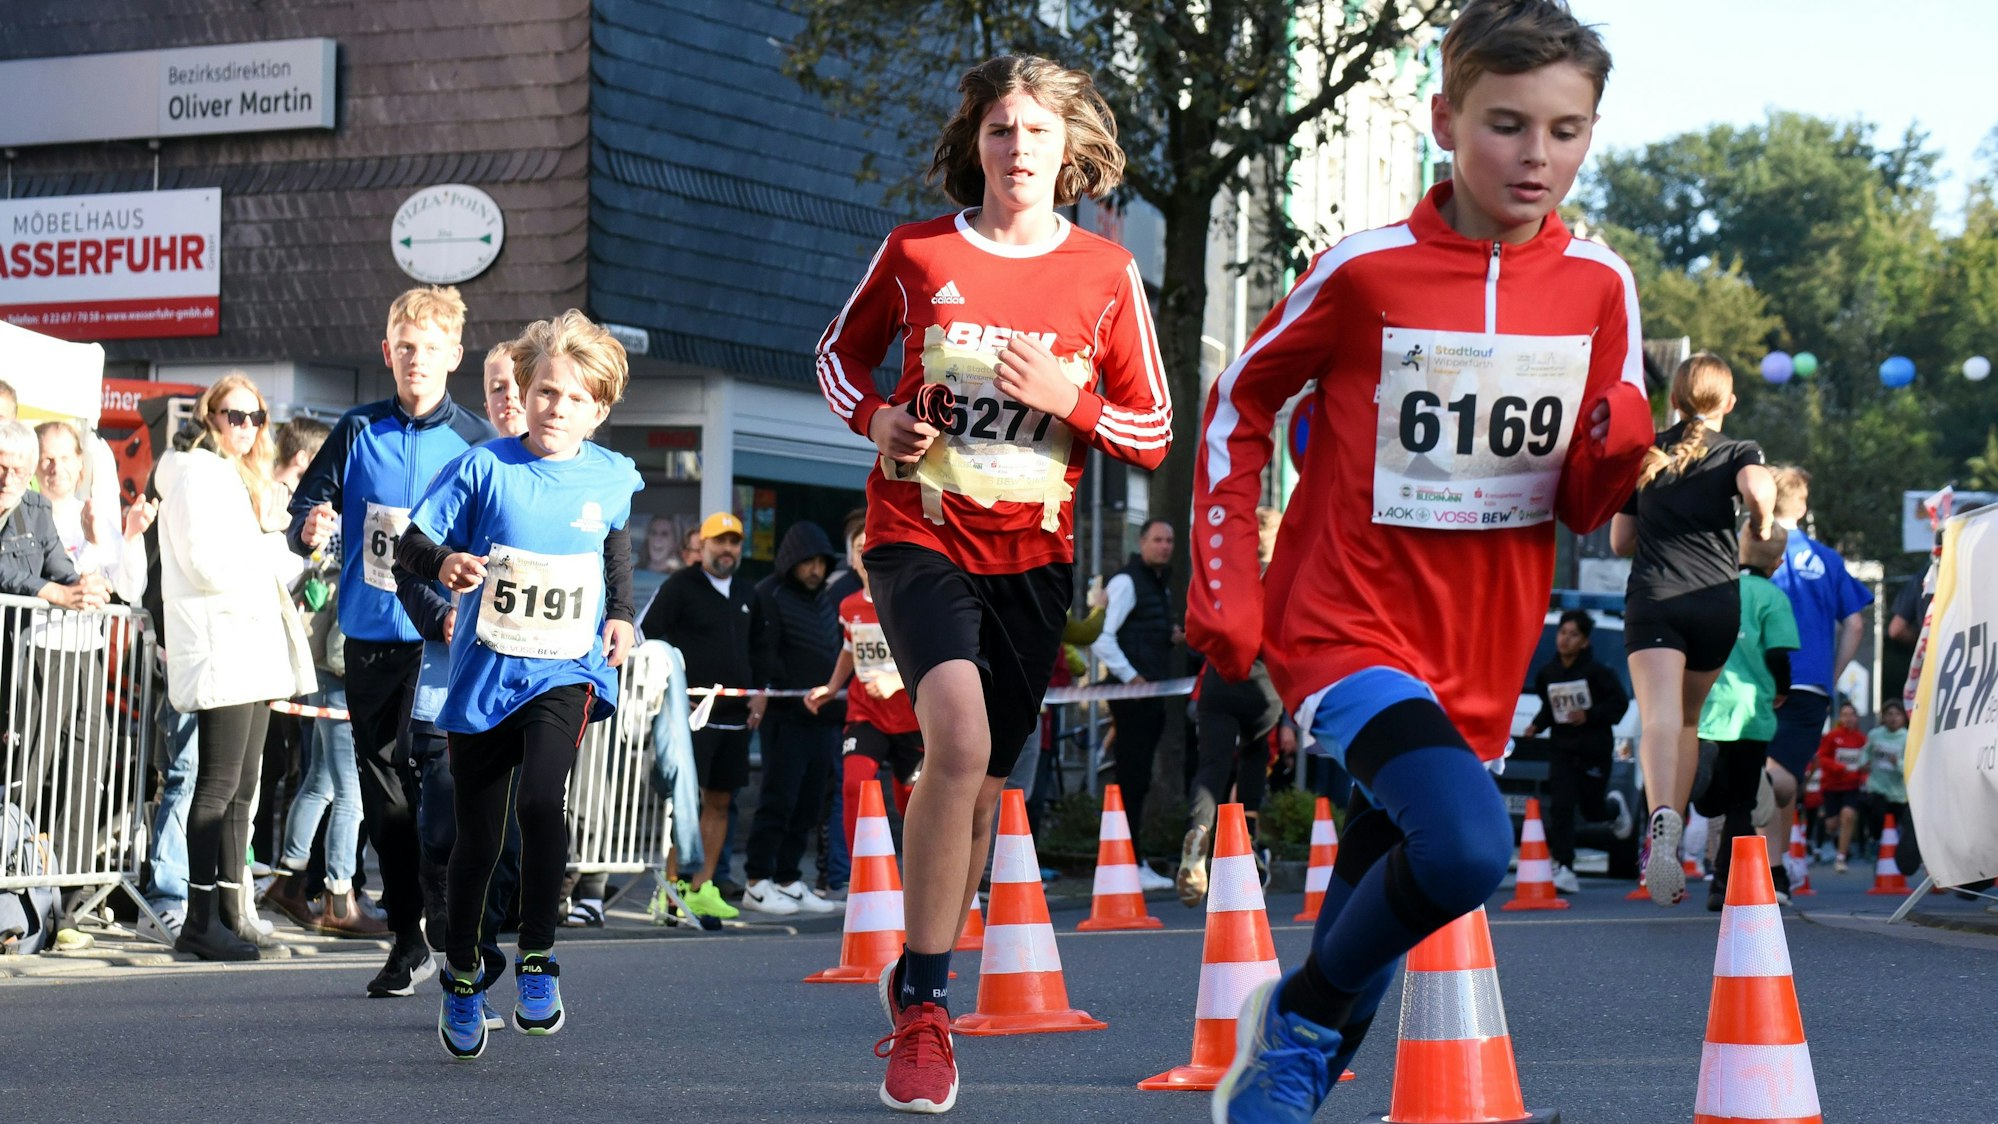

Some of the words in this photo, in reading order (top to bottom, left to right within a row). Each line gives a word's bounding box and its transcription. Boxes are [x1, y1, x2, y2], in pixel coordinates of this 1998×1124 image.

[168, 59, 291, 85] Bezirksdirektion
[168, 92, 232, 120] Oliver
[240, 86, 312, 115] Martin
[13, 208, 144, 235] MÖBELHAUS
[397, 194, 441, 228] PIZZA
[450, 191, 499, 227] POINT
[1434, 356, 1494, 369] Wipperfürth
[1435, 344, 1494, 357] Stadtlauf
[944, 395, 1054, 442] 5277
[1399, 390, 1563, 457] 6169
[1385, 507, 1413, 520] AOK
[1433, 511, 1478, 524] VOSS
[1481, 511, 1511, 524] BEW
[493, 578, 584, 621] 5191
[856, 641, 892, 660] 556
[1934, 621, 1998, 735] BEW
[522, 965, 542, 973] FILA
[454, 986, 474, 994] FILA
